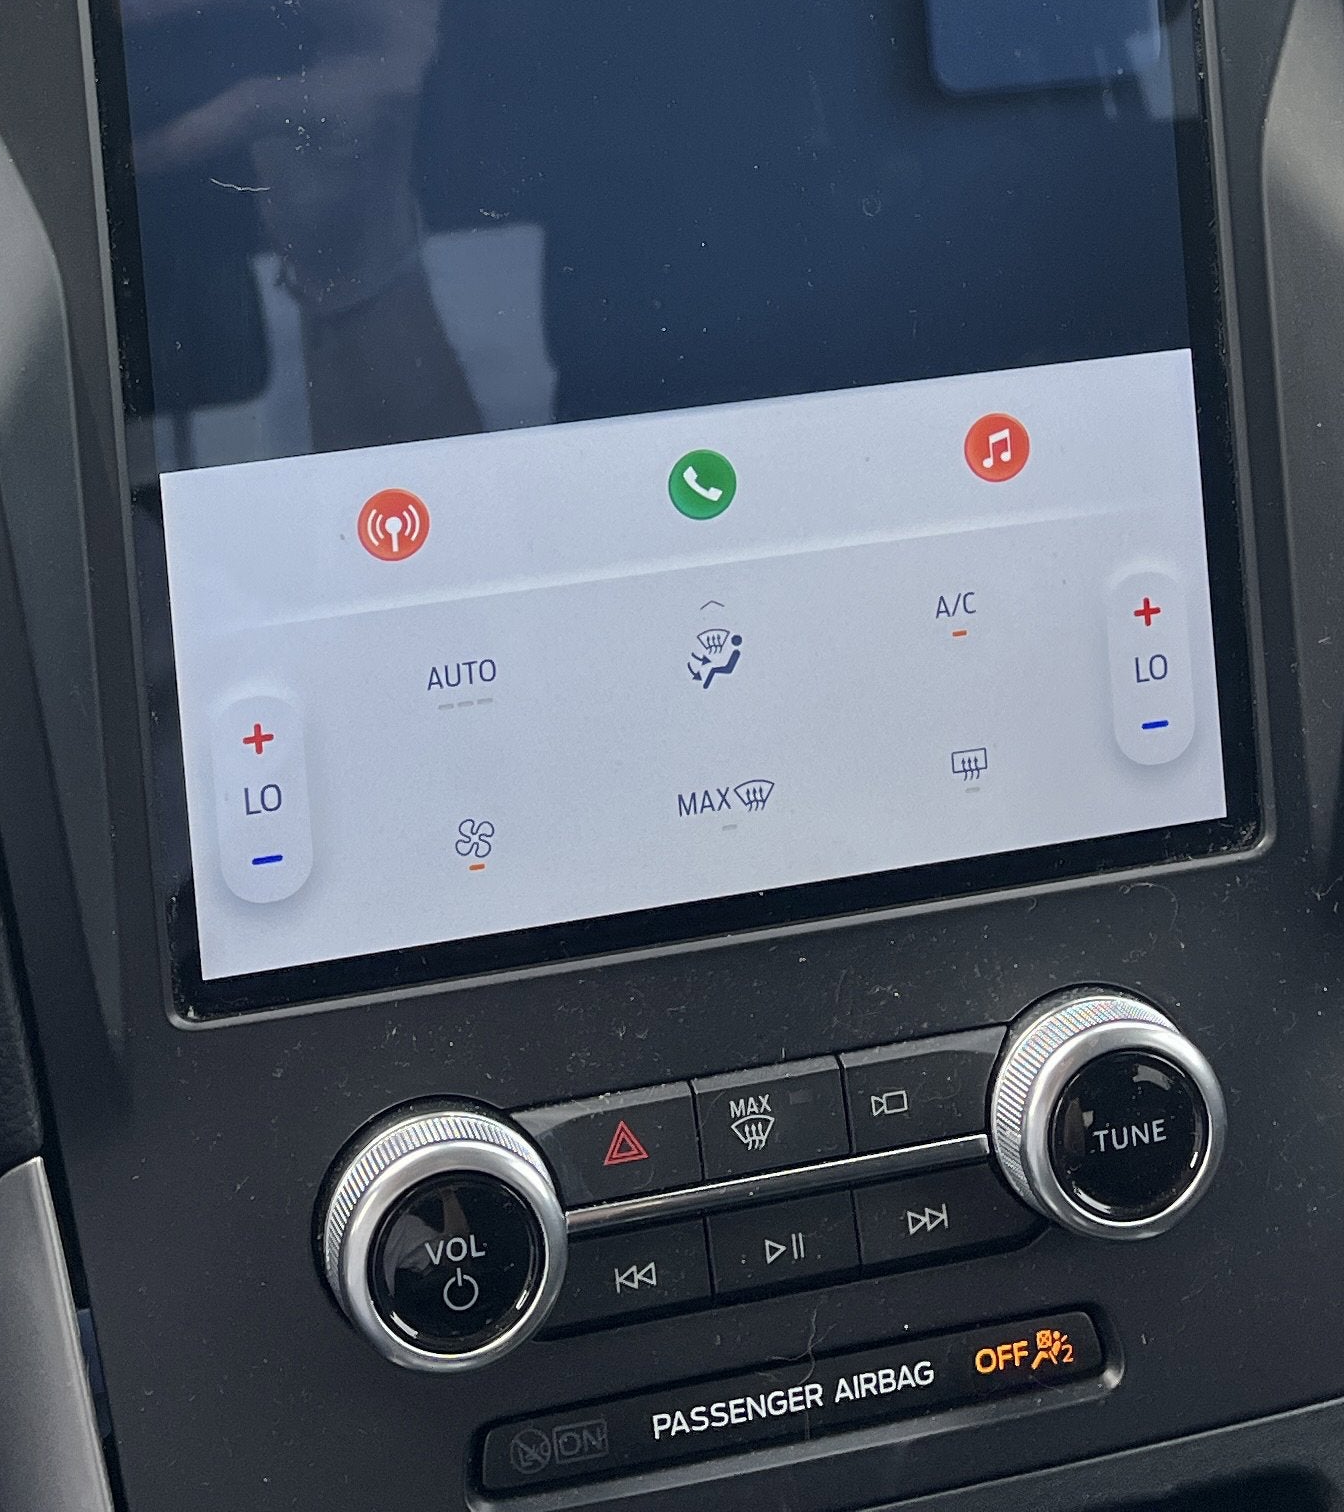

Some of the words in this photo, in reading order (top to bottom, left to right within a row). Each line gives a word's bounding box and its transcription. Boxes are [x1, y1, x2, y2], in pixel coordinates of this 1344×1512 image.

[935, 591, 977, 619] A/C
[427, 658, 497, 691] AUTO
[1134, 653, 1168, 684] LO
[244, 783, 282, 816] LO
[677, 786, 732, 818] MAX
[729, 1094, 772, 1116] MAX
[1093, 1118, 1167, 1152] TUNE
[425, 1236, 486, 1265] VOL
[975, 1340, 1029, 1374] OFF
[652, 1383, 824, 1438] PASSENGER
[834, 1360, 935, 1403] AIRBAG
